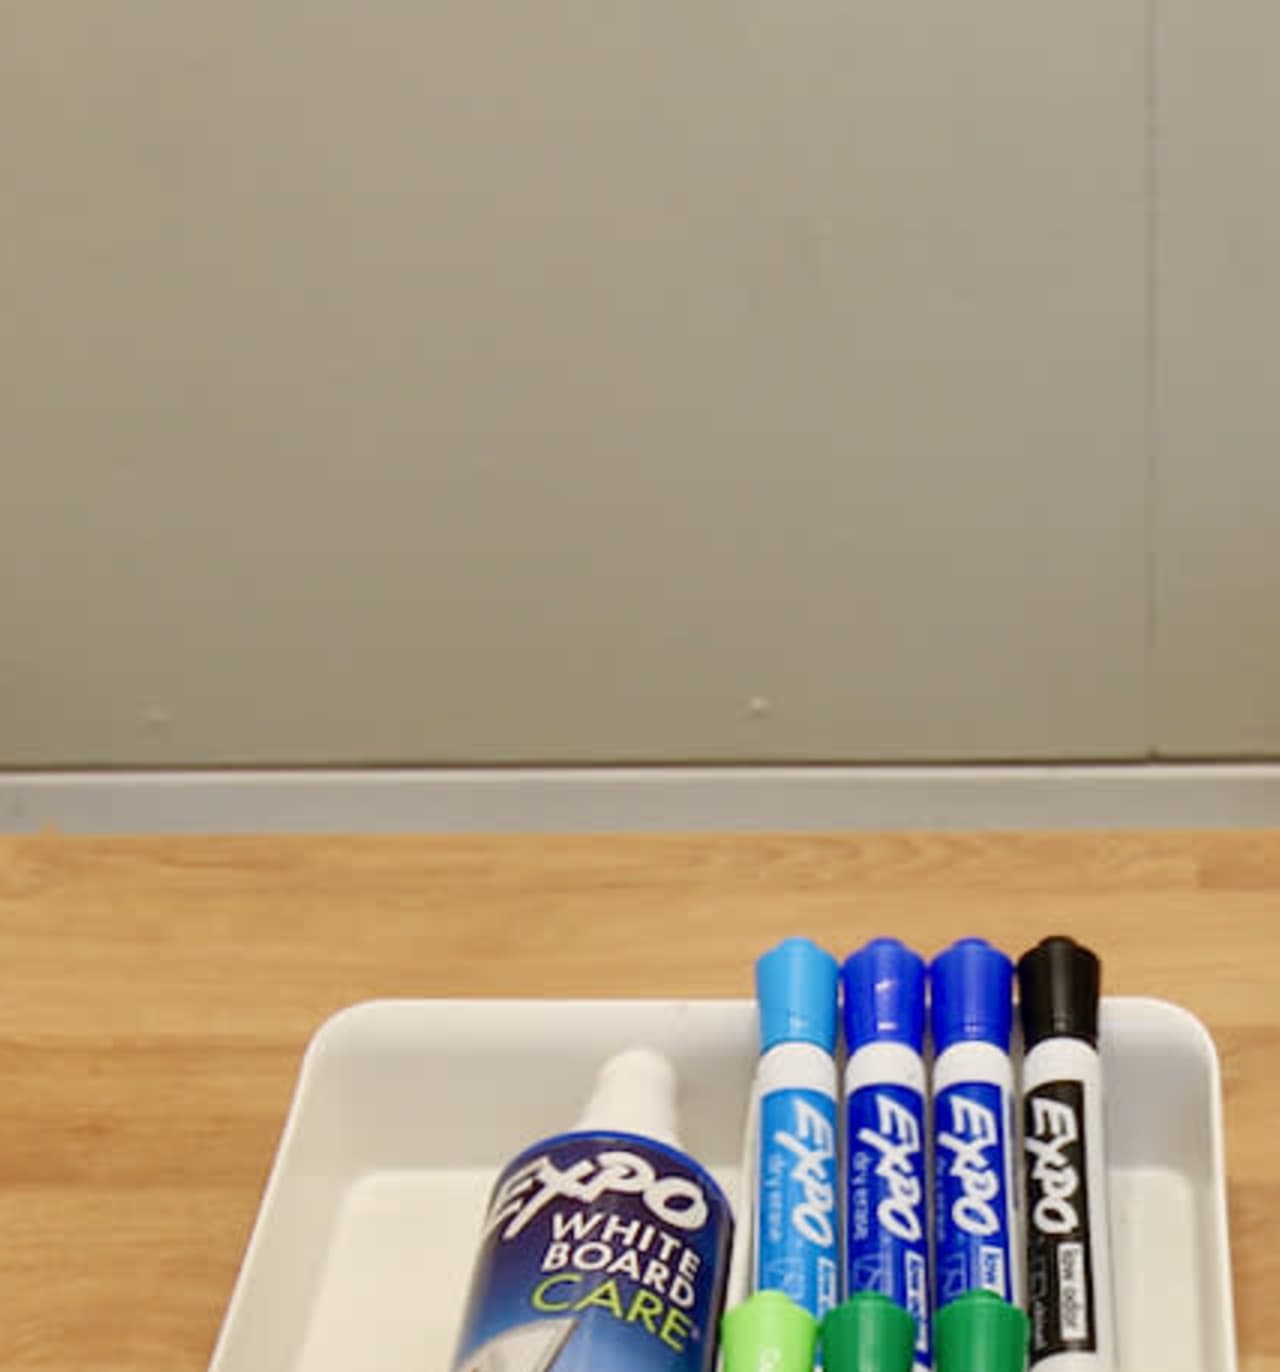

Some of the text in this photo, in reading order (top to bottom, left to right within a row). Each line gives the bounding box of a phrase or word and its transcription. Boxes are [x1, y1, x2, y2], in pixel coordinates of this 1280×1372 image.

[482, 1150, 708, 1241] EXPO
[774, 1096, 834, 1248] EXPO
[857, 1093, 922, 1242] EXPO
[937, 1093, 1000, 1235] EXPO
[1024, 1096, 1080, 1235] EXPO
[541, 1241, 695, 1308] BOARD
[553, 1211, 701, 1281] WHITE
[532, 1273, 693, 1352] CARE
